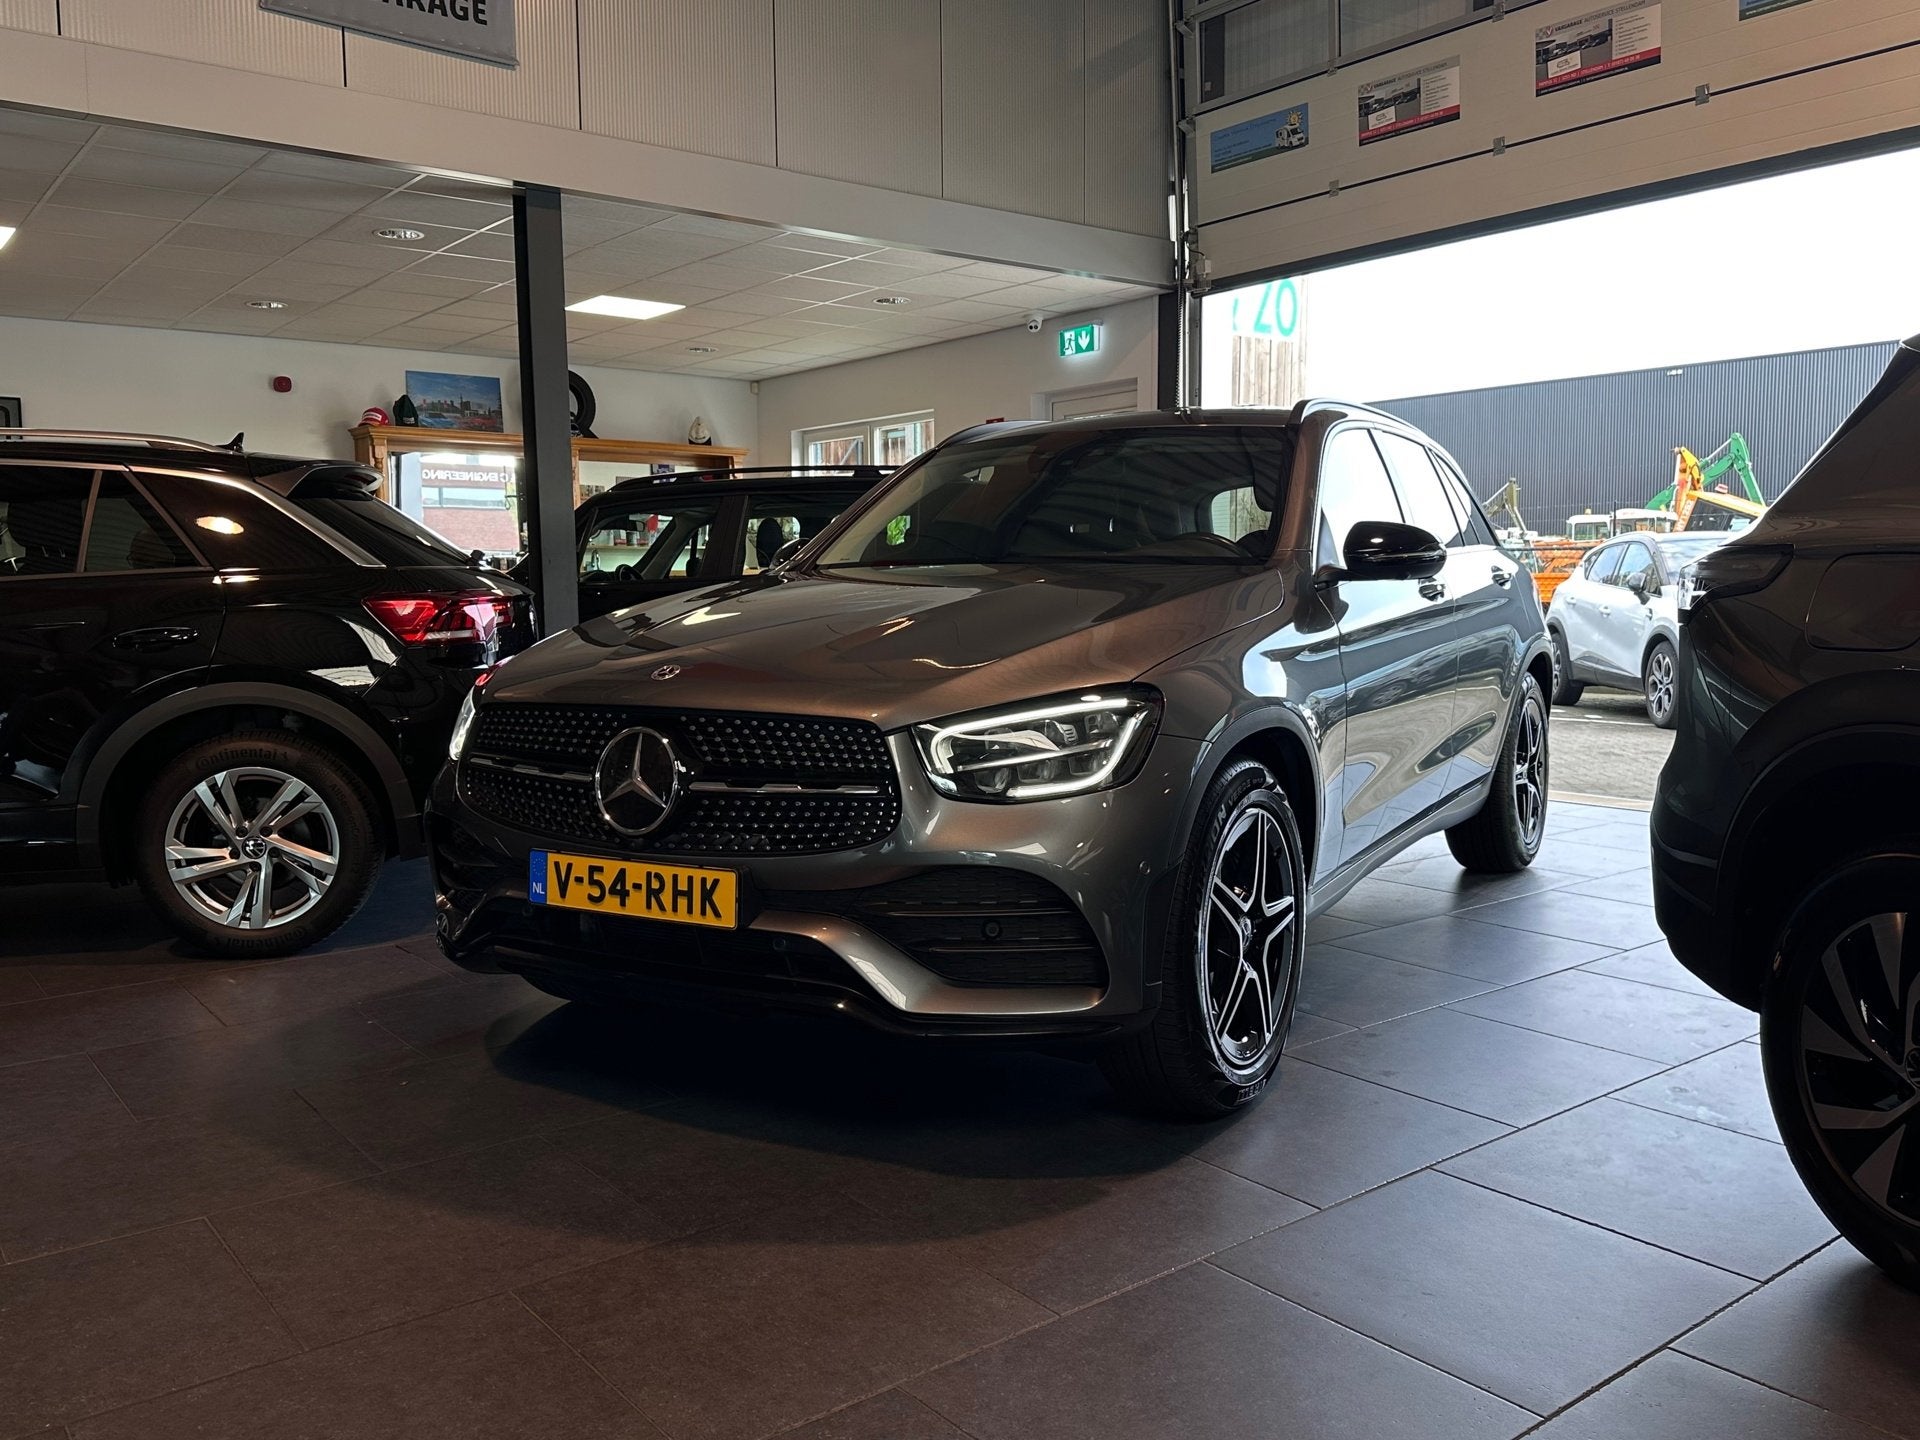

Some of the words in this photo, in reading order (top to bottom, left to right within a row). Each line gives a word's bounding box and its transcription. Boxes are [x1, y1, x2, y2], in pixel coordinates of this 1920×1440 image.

[382, 0, 488, 26] AGE
[531, 881, 546, 896] NL
[553, 860, 723, 919] V-54-RHK
